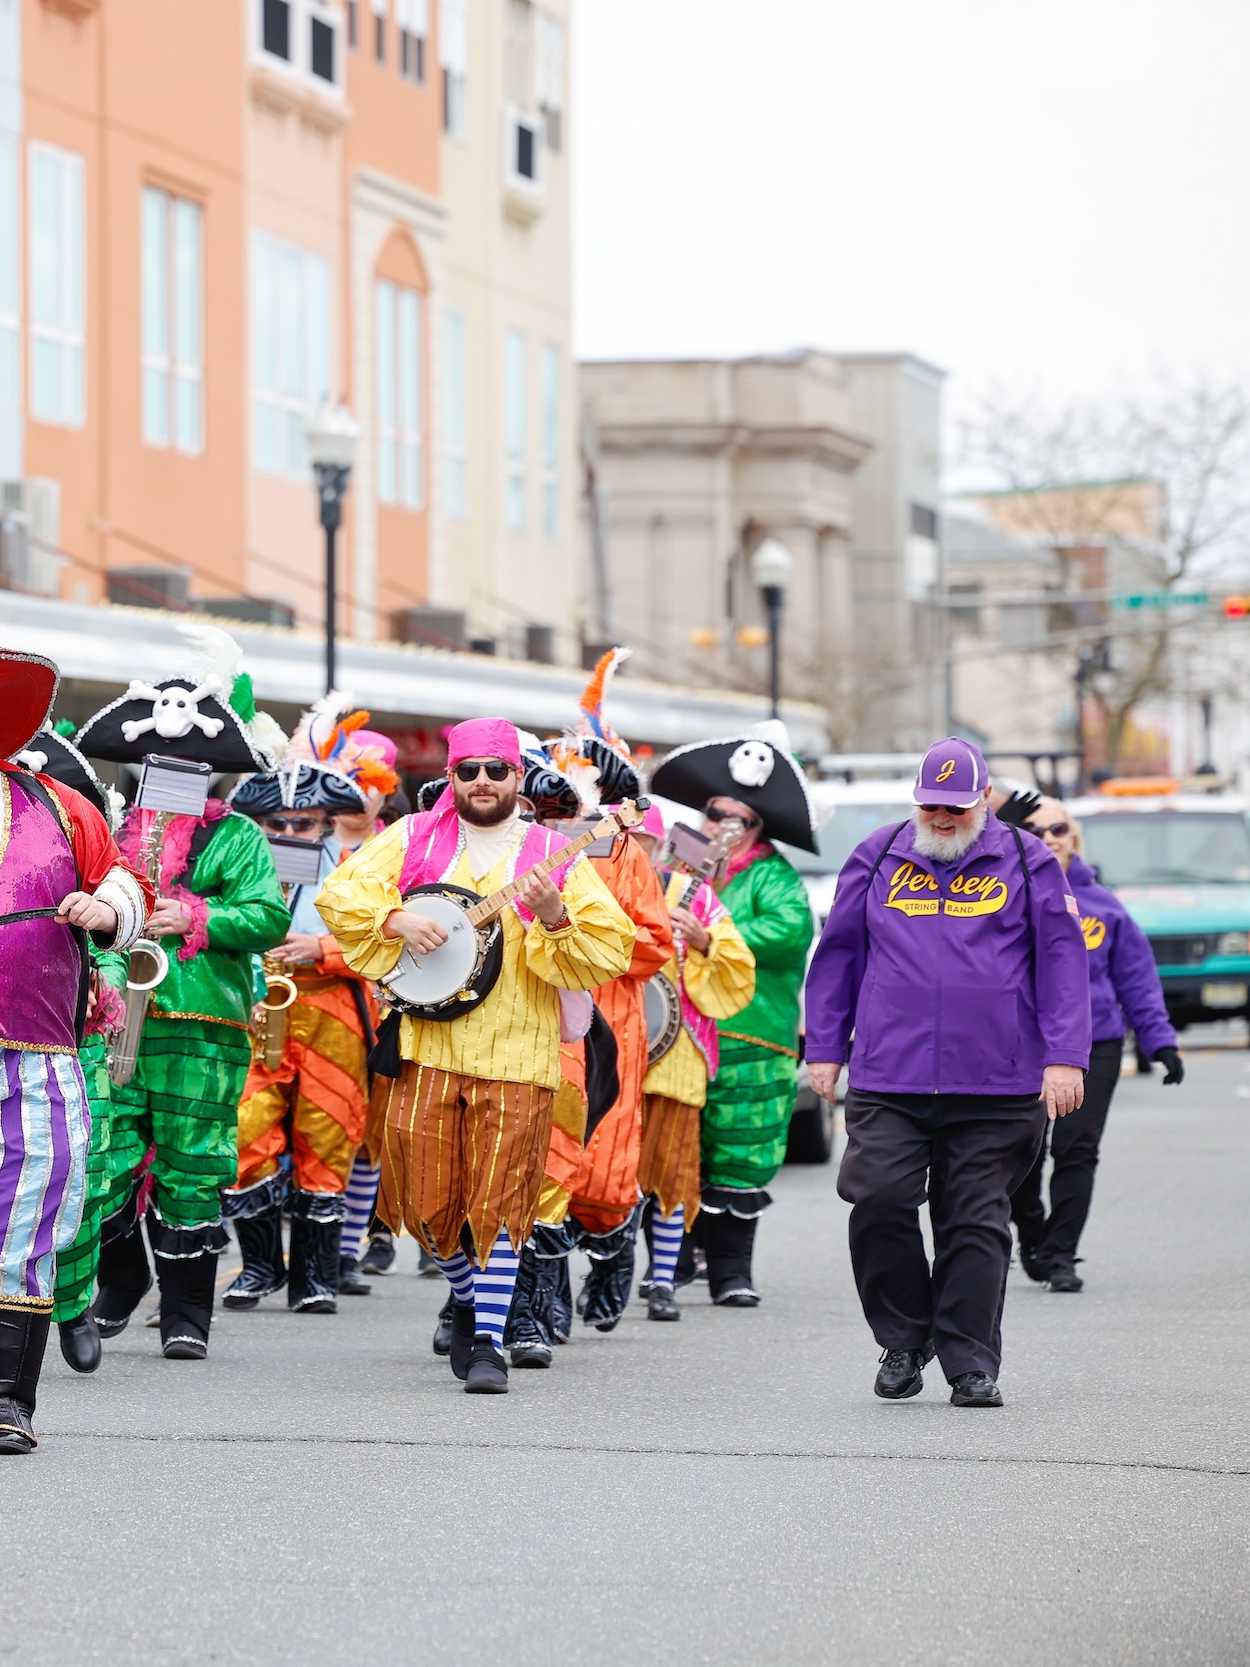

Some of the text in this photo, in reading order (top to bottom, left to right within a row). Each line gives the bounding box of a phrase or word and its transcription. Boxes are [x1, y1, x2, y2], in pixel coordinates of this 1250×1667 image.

[935, 759, 956, 783] J
[888, 860, 1008, 903] Jersey
[904, 903, 974, 914] STRING BAND
